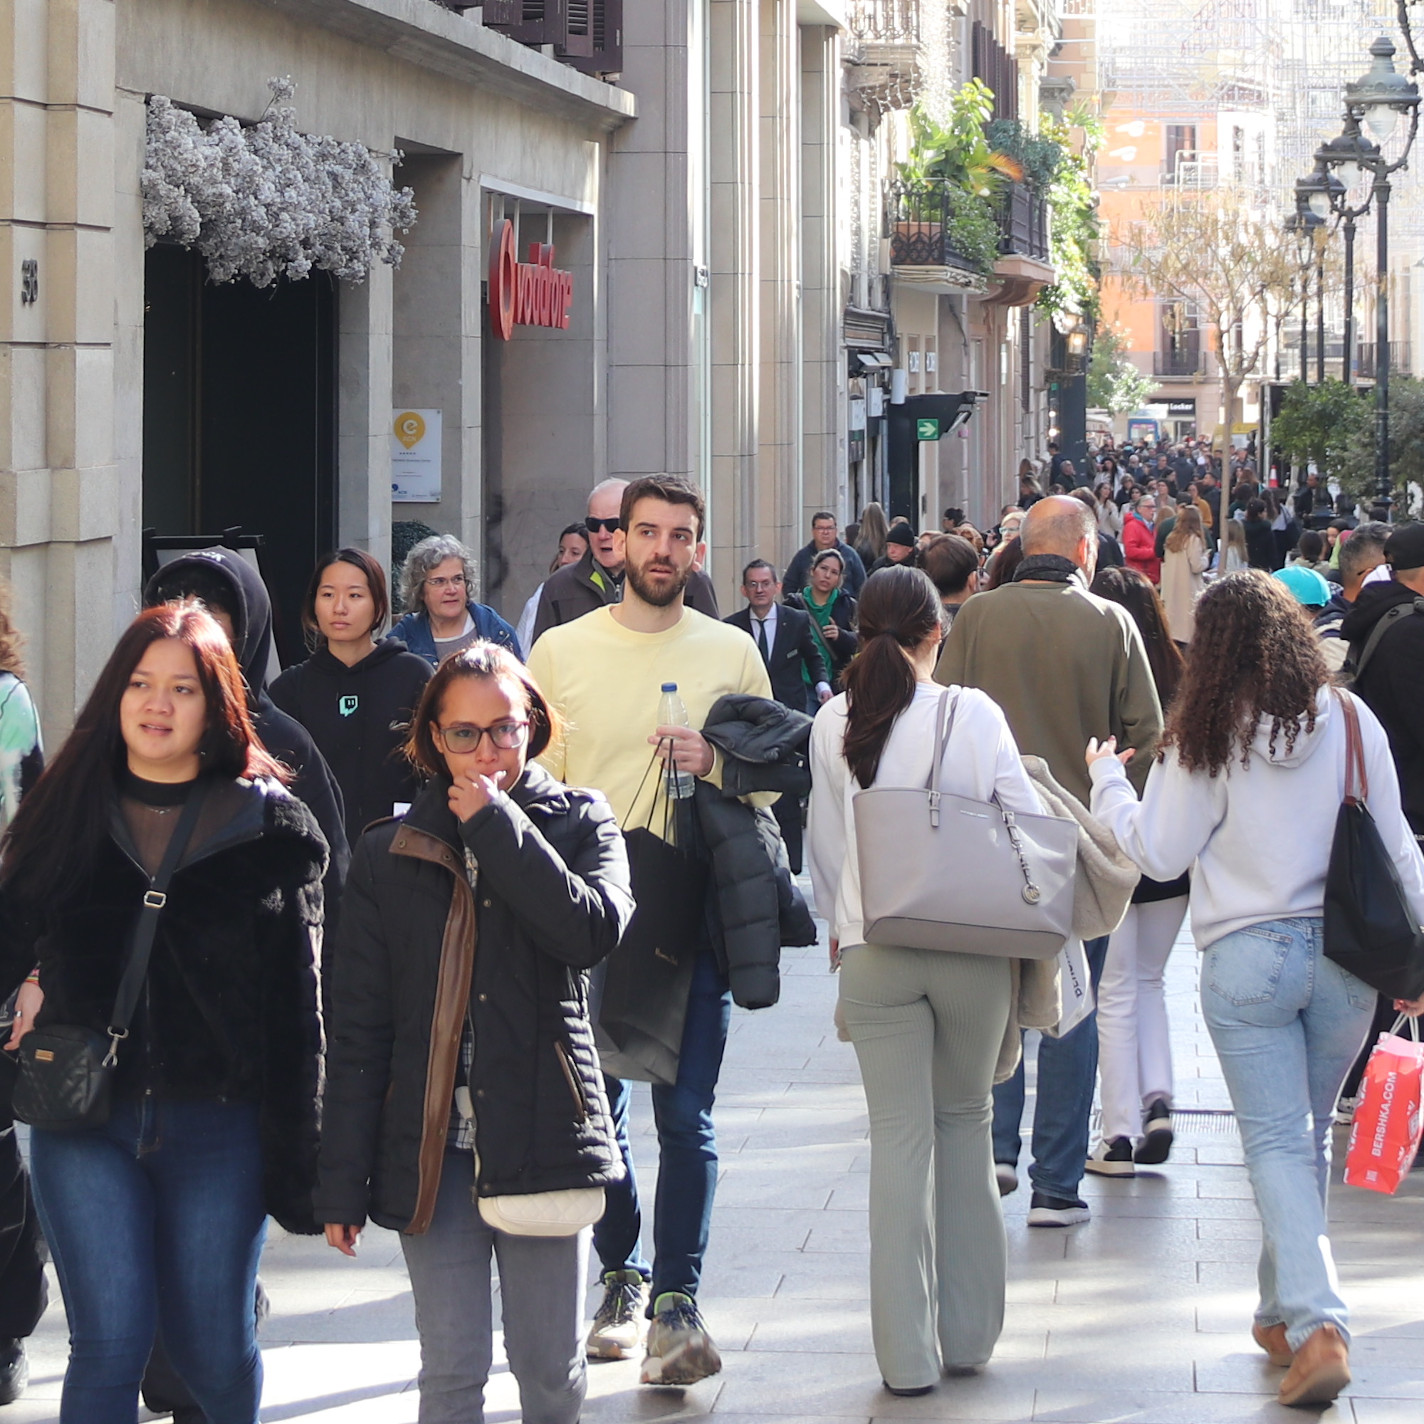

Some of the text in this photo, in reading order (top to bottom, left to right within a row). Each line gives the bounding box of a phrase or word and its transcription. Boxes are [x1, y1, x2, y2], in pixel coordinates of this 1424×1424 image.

[21, 259, 38, 304] 38
[513, 242, 574, 331] vodafone
[1371, 1071, 1398, 1158] BERSHKA.COM
